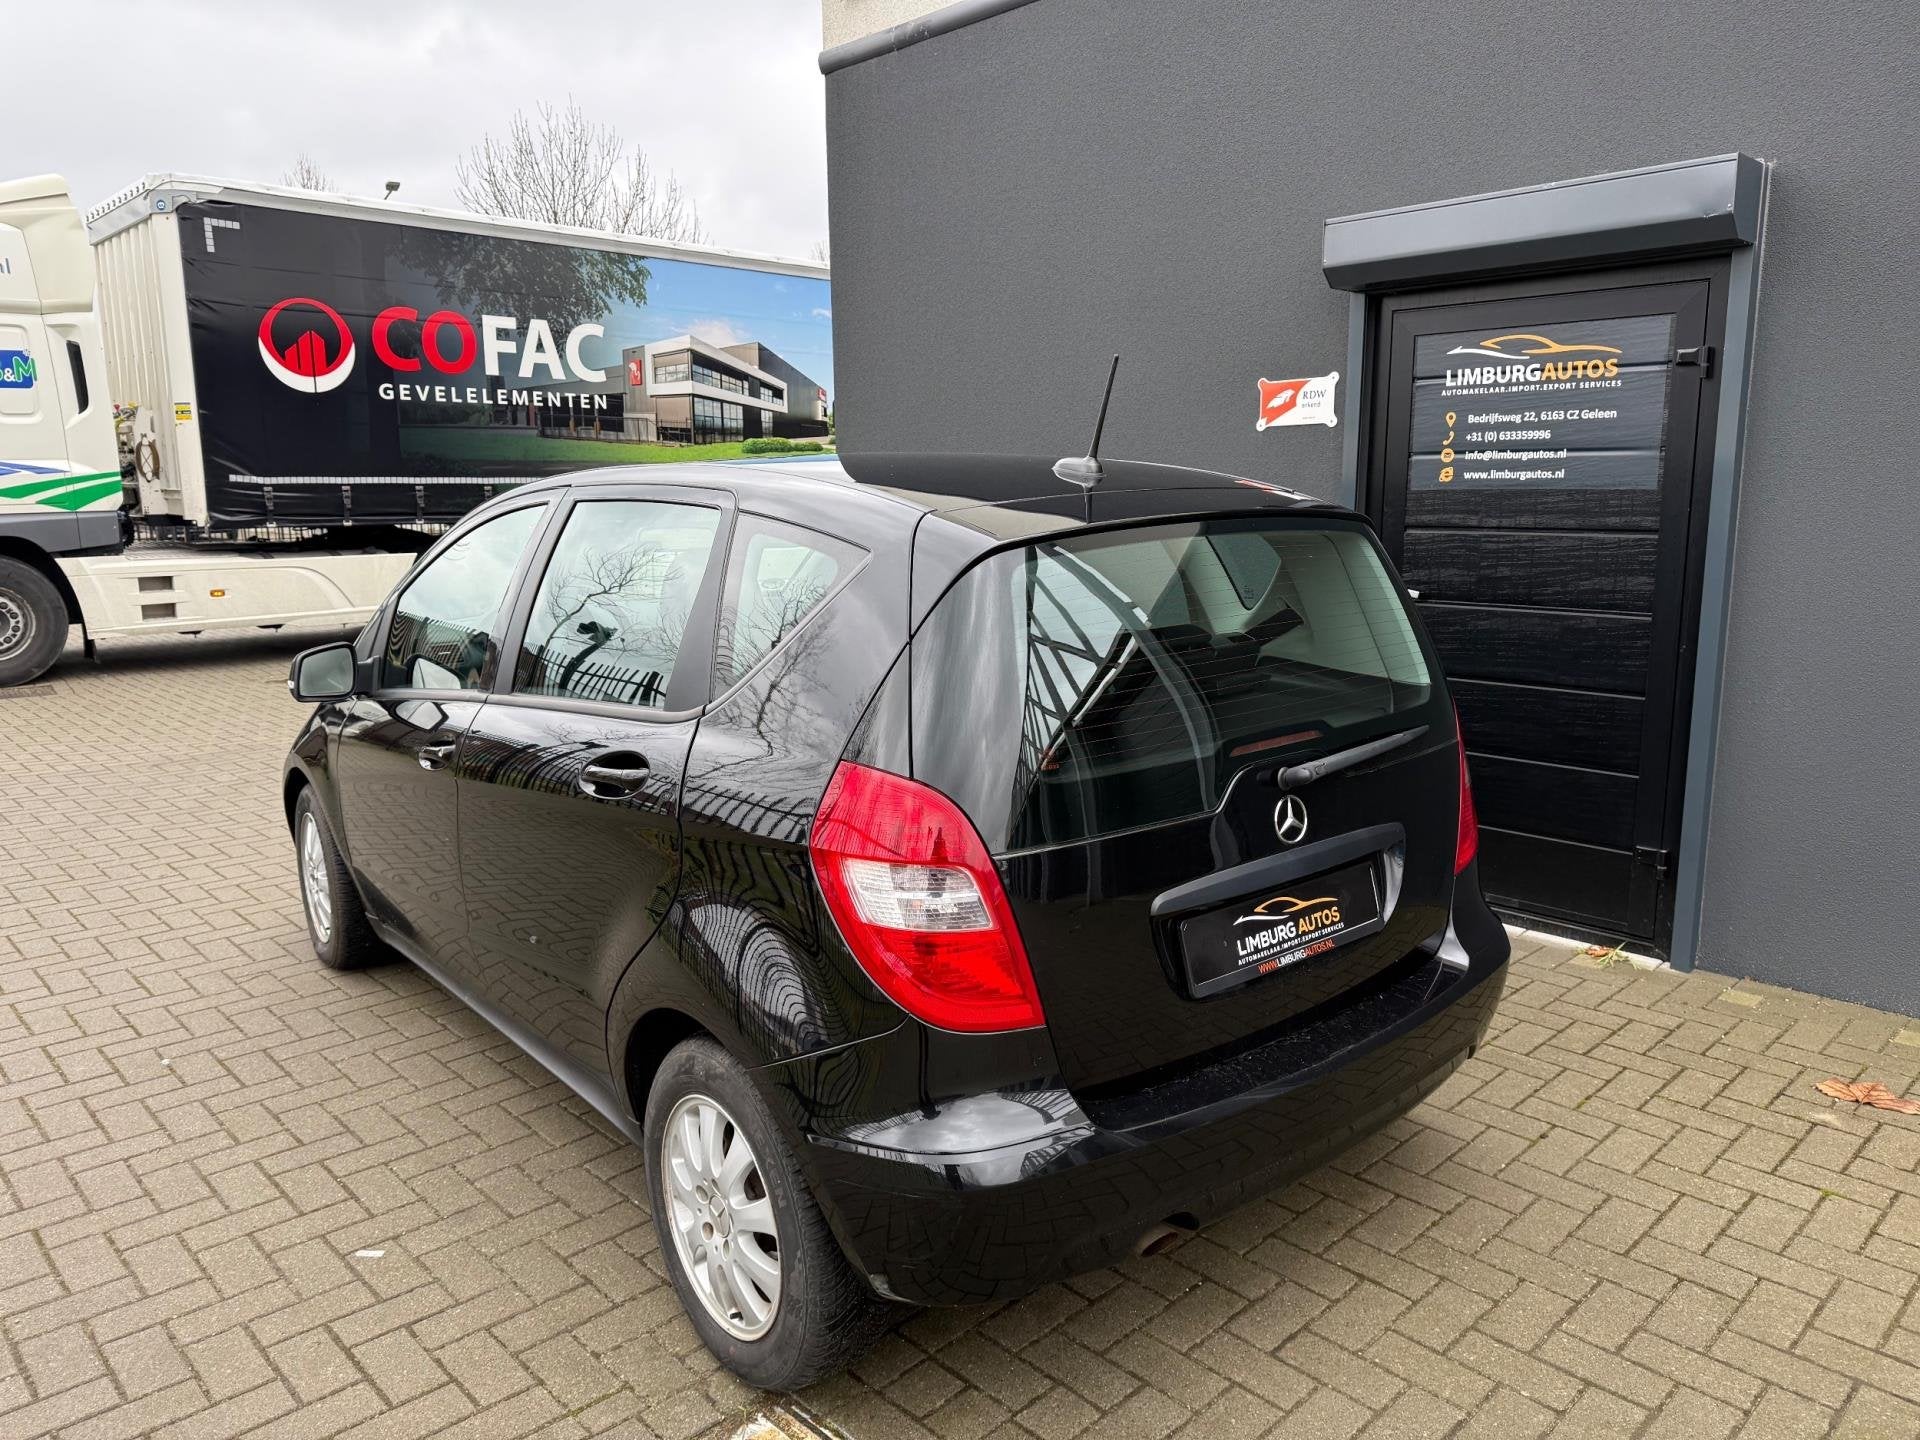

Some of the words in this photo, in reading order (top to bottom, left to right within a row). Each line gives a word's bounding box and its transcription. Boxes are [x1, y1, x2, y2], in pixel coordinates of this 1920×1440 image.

[371, 306, 607, 383] COFAC
[0, 355, 38, 382] &M
[1445, 358, 1618, 387] LIMBURGAUTOS
[1579, 380, 1622, 389] SERVICES
[378, 383, 608, 409] GEVELELEMENTEN
[1302, 389, 1327, 400] RDW
[1467, 413, 1522, 425] Bedrijfsweg
[1523, 412, 1538, 423] 22,
[1540, 410, 1565, 421] 6163
[1566, 410, 1580, 420] CZ
[1581, 408, 1617, 419] Geleen
[1465, 432, 1483, 442] +31
[1484, 431, 1497, 443] (0)
[1498, 430, 1551, 441] 633359996
[1464, 448, 1567, 461] info@limburgautos.nl
[1463, 468, 1565, 481] www.limburgautos.nl
[1237, 921, 1297, 956] LIMBURG
[1298, 906, 1340, 934] AUTOS
[1322, 922, 1345, 935] SERVICES
[1258, 939, 1335, 974] WWW.LIMBURGAUTOS.NL
